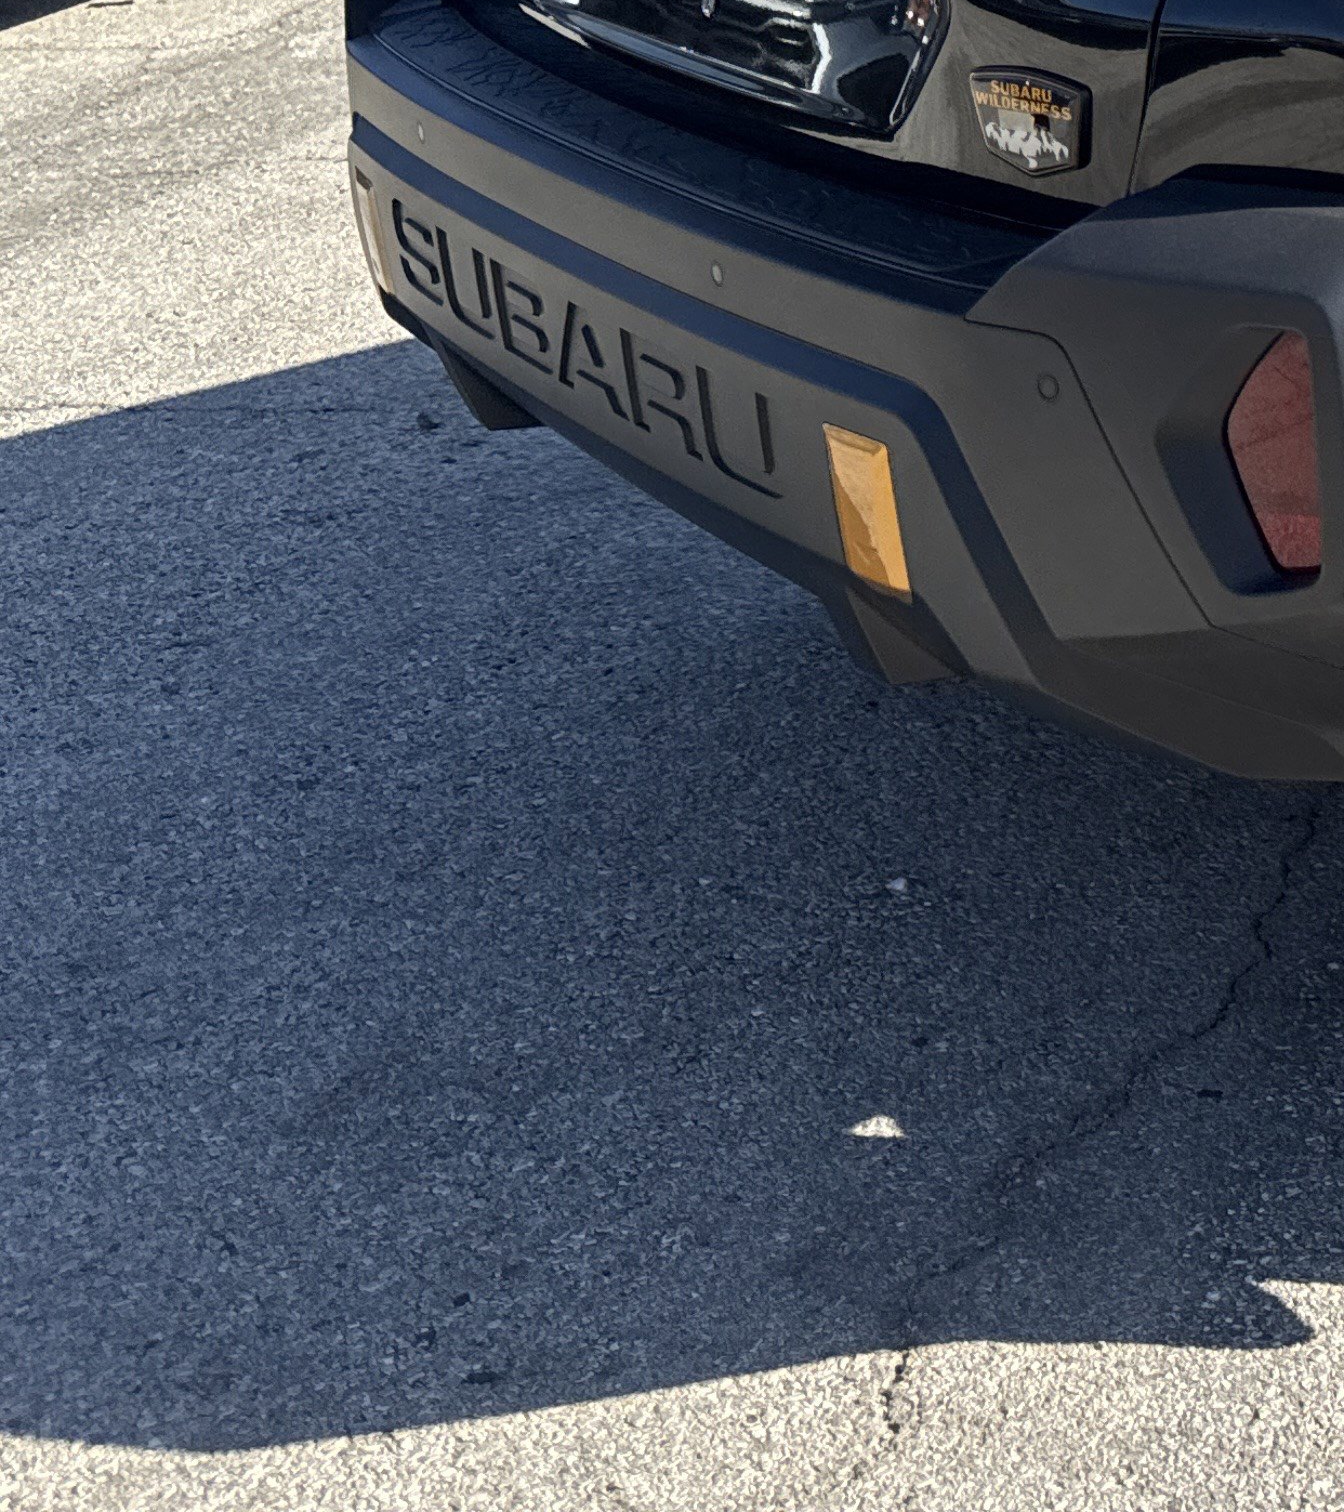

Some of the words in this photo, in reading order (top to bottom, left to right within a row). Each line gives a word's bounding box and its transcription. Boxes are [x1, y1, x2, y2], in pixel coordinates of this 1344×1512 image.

[974, 90, 1072, 121] WILDERNESS
[990, 79, 1052, 102] SUBARU
[391, 197, 784, 500] SUBARU
